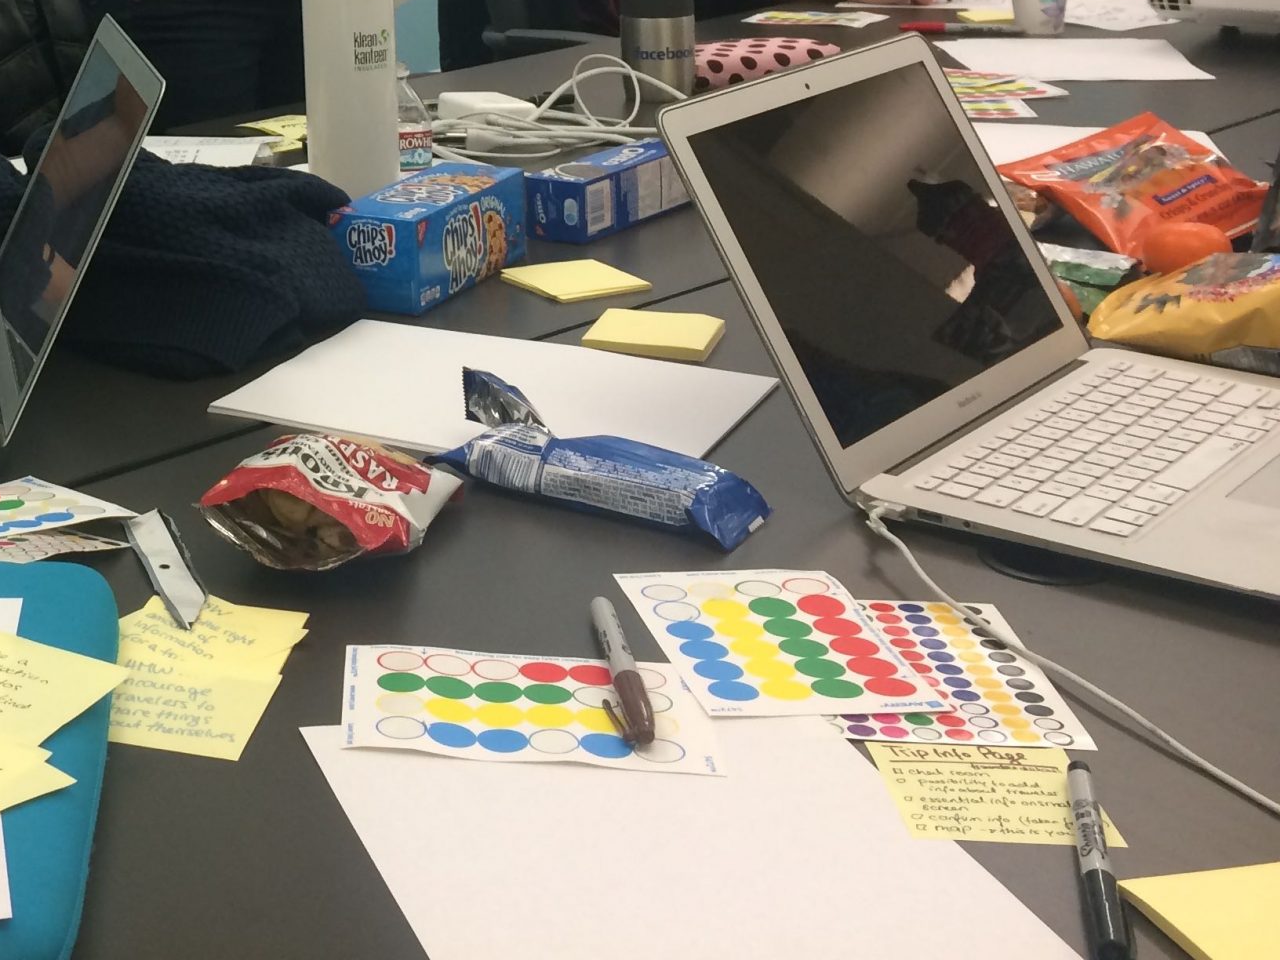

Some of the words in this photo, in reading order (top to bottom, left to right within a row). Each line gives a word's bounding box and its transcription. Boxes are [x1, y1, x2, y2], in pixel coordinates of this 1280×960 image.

[353, 31, 378, 48] klean
[353, 48, 388, 65] kanteen
[347, 223, 387, 248] Chips
[442, 211, 476, 271] Chips
[935, 747, 972, 761] Info
[976, 746, 1029, 767] Page
